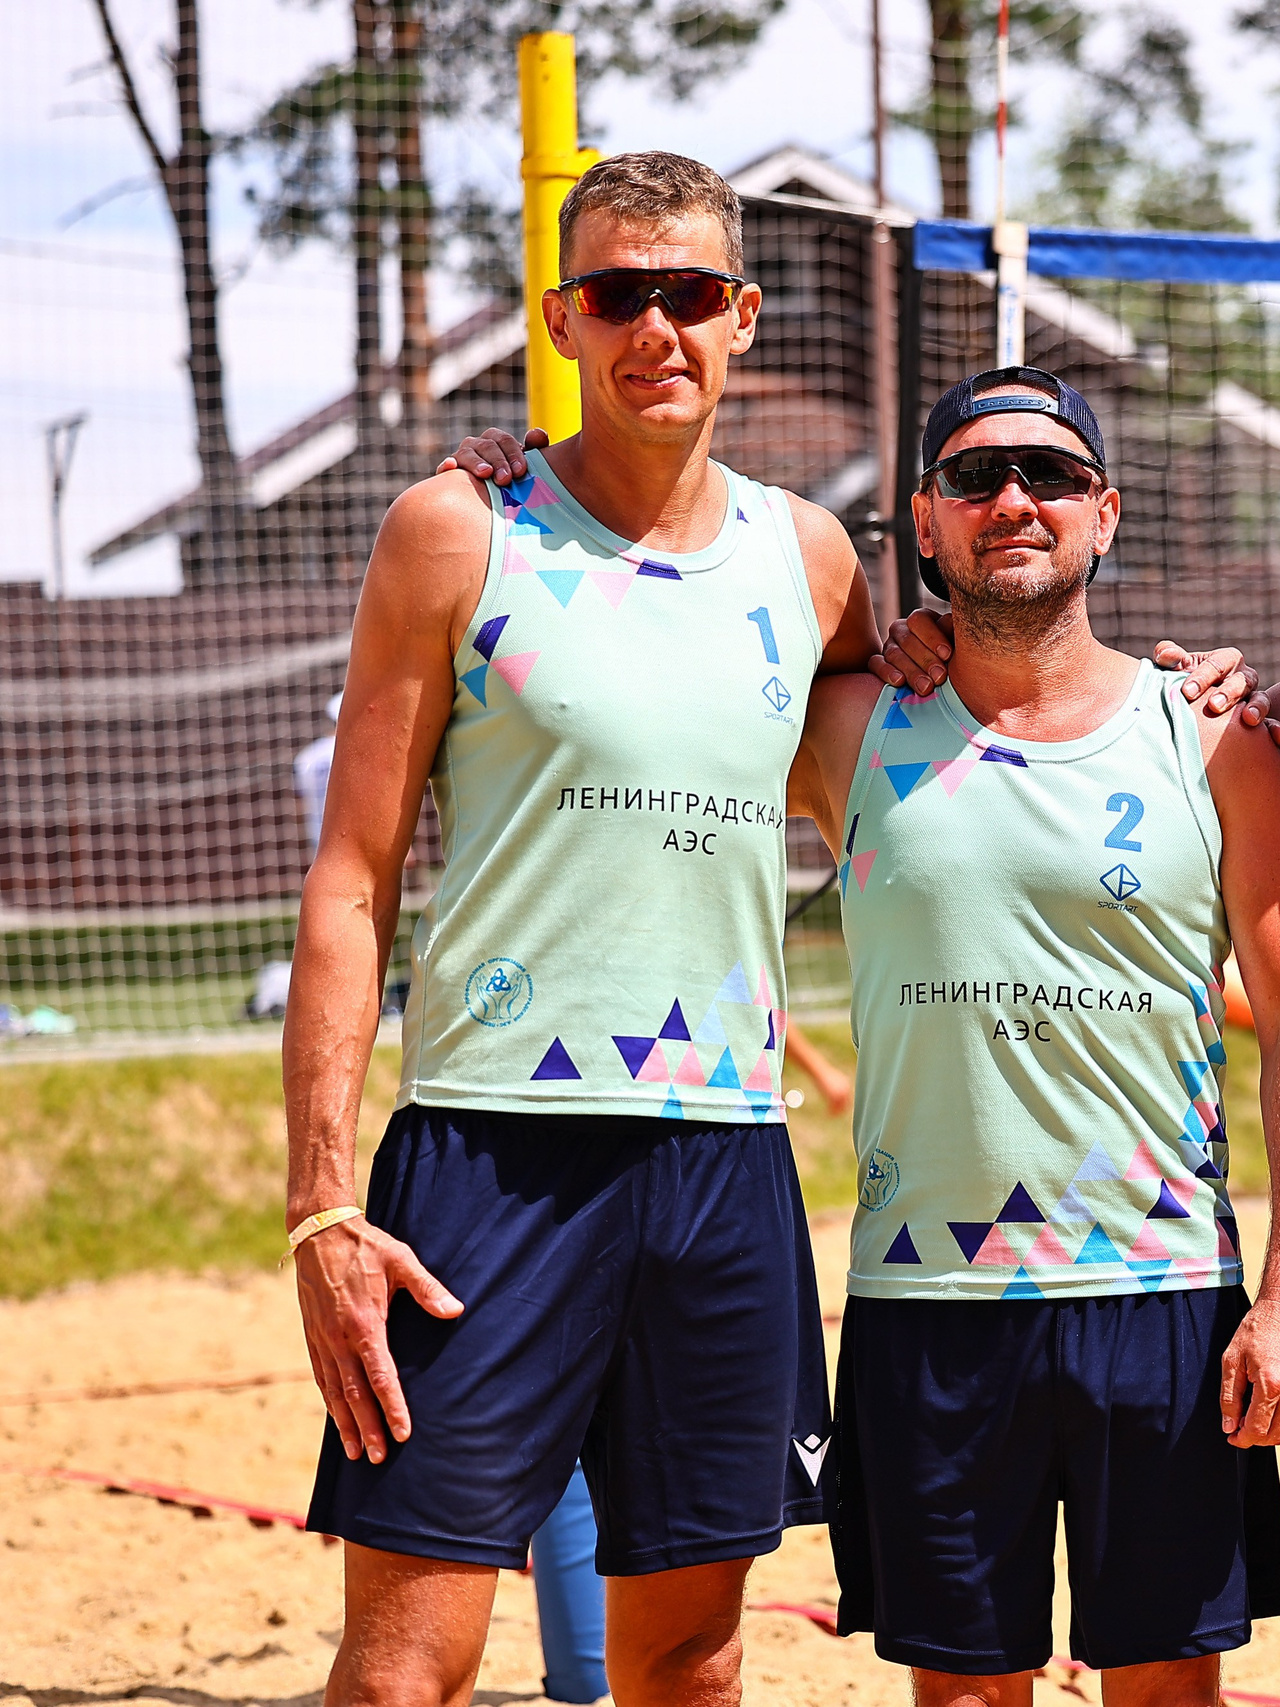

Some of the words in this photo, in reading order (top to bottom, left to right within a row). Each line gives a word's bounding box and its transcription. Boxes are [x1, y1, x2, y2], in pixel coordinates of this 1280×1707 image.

[746, 606, 781, 665] 1
[764, 711, 794, 725] SPORTART
[556, 787, 784, 830] ЛЕНИНГРАДСКАЯ
[1104, 792, 1145, 852] 2
[662, 829, 717, 855] АЭС
[1097, 901, 1139, 913] SPORTART
[899, 981, 1152, 1013] ЛЕНИНГРАДСКАЯ
[992, 1019, 1051, 1042] АЭС
